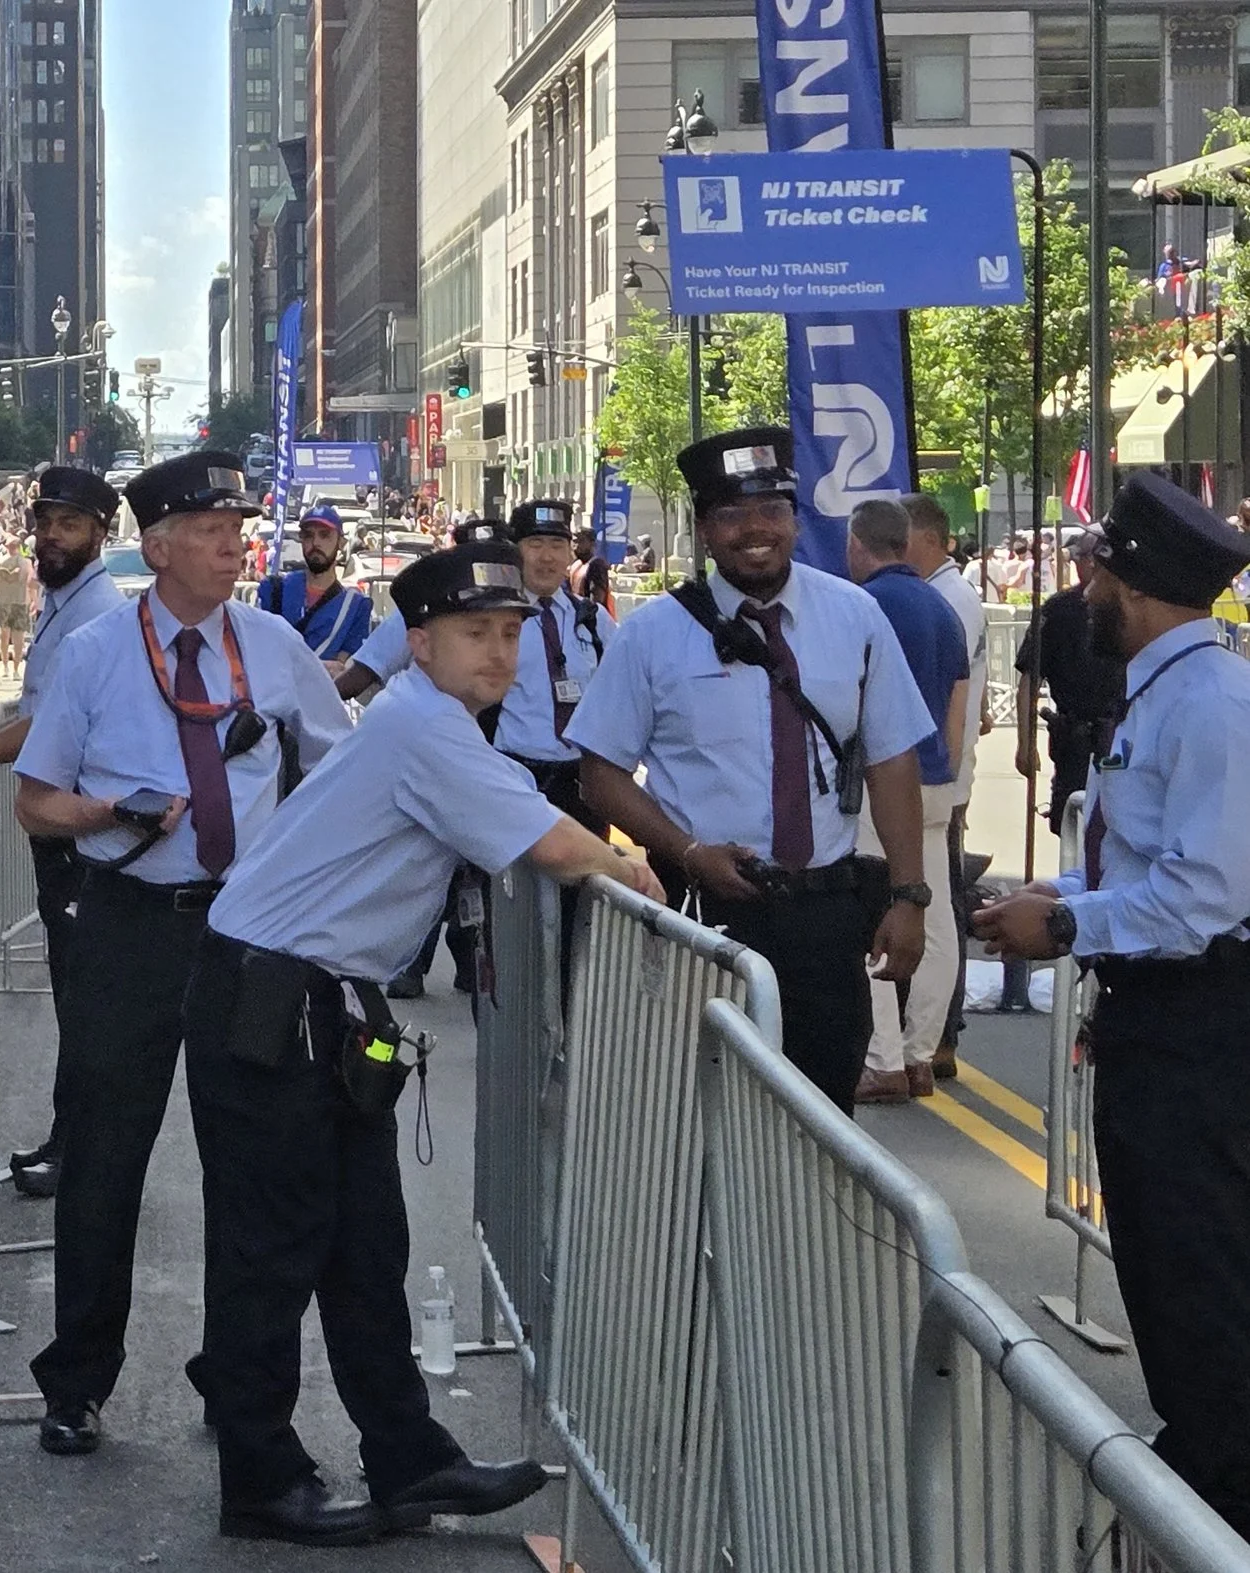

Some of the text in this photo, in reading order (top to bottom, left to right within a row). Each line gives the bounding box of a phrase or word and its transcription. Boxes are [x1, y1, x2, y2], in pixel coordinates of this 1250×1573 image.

[761, 179, 905, 199] NJ TRANSIT
[765, 204, 928, 227] Ticket Check
[685, 261, 850, 279] Have Your NJ TRANSIT
[686, 281, 885, 300] Ticket Ready for Inspection
[429, 412, 438, 455] PAR
